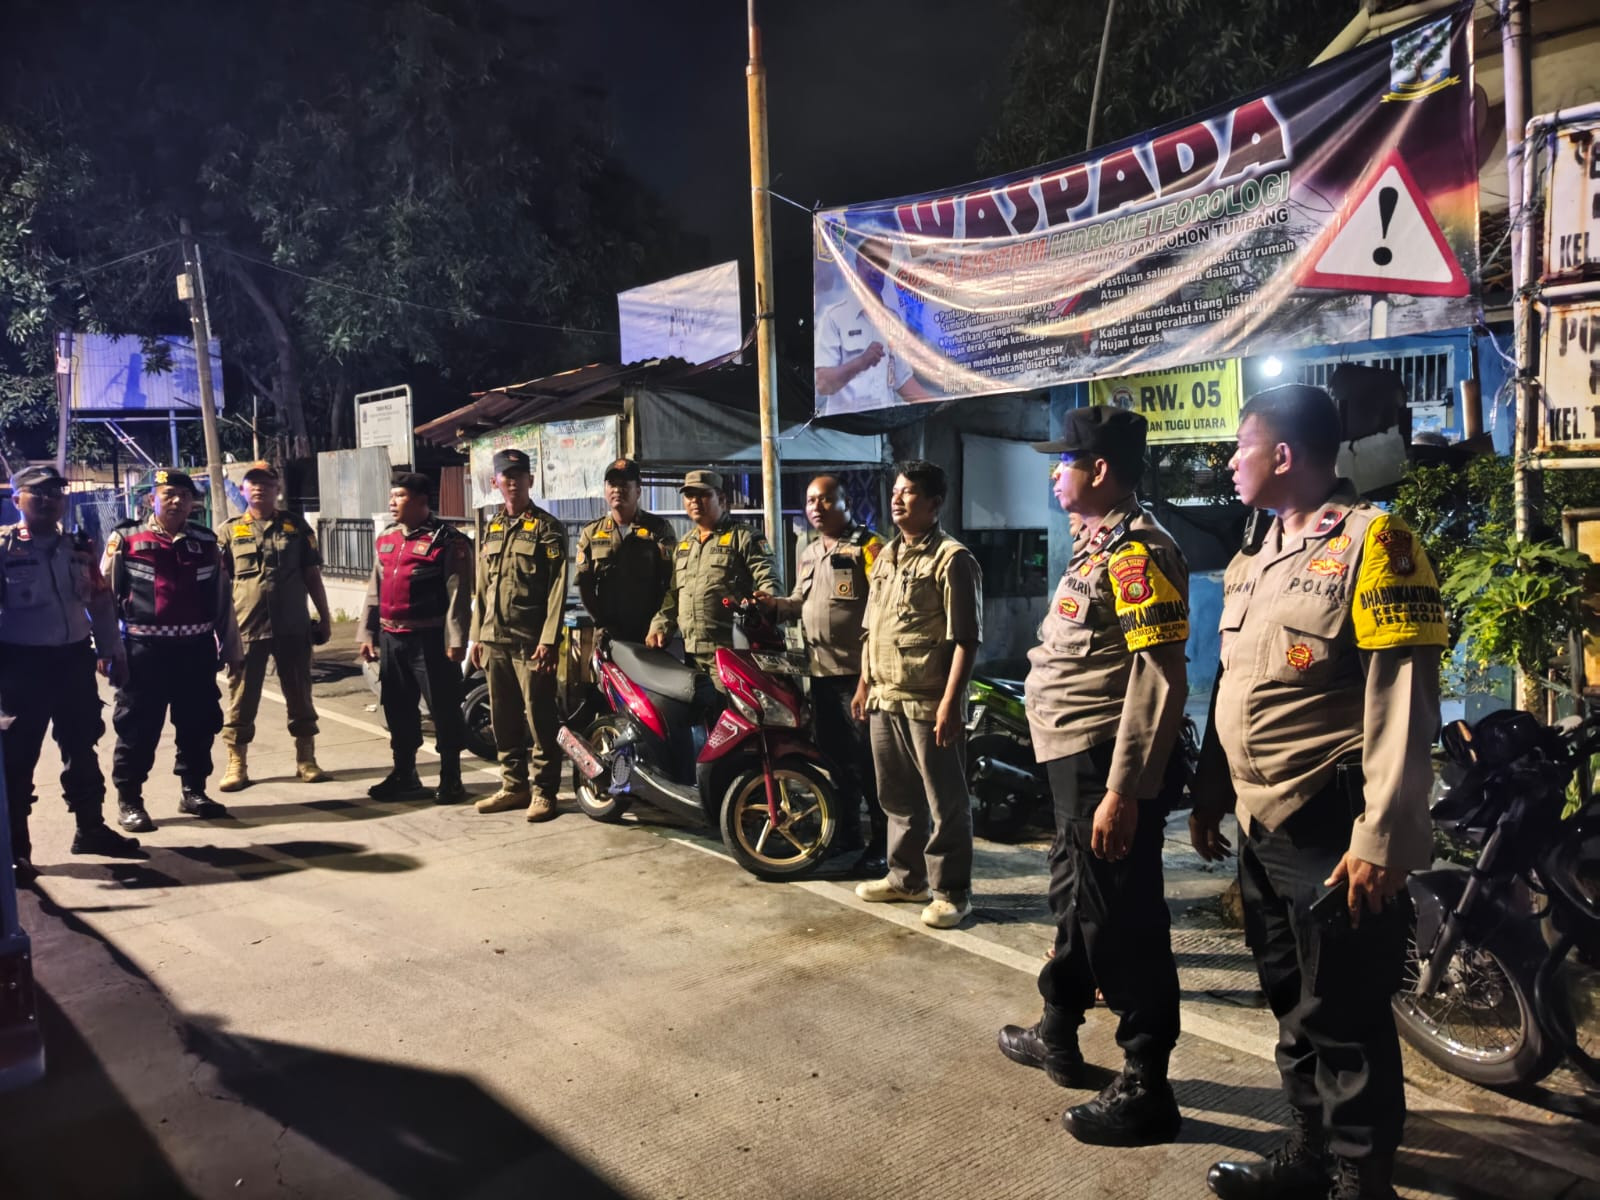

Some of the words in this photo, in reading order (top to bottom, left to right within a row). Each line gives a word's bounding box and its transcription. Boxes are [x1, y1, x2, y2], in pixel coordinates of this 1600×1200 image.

[896, 97, 1292, 258] WASPADA
[959, 238, 1048, 279] EKSTRIM
[1049, 171, 1291, 259] HIDROMETEOROLOGI
[1128, 234, 1158, 256] DAN
[1157, 226, 1210, 250] POHON
[1214, 208, 1289, 239] TUMBANG
[1100, 273, 1144, 290] Pastikan
[1146, 264, 1184, 281] saluran
[1202, 249, 1251, 268] disekitar
[1255, 240, 1295, 257] rumah
[1100, 289, 1124, 301] Atau
[1205, 264, 1241, 280] dalam
[969, 311, 1005, 327] informasi
[1136, 304, 1192, 322] mendekati
[1193, 296, 1223, 312] tiang
[1226, 291, 1258, 306] listrik
[943, 331, 981, 347] Perhatikan
[1098, 325, 1127, 340] Kabel
[1129, 321, 1153, 335] atau
[1155, 311, 1206, 332] peralatan
[966, 341, 986, 353] deras
[987, 336, 1009, 351] angin
[1099, 337, 1130, 351] Hujan
[1132, 332, 1164, 347] deras.
[973, 355, 1012, 369] mendekati
[1012, 349, 1039, 364] pohon
[1040, 345, 1064, 357] besar
[992, 364, 1024, 378] kencang
[1026, 358, 1058, 371] disertai
[1140, 383, 1185, 413] RW.
[1191, 380, 1222, 409] 05
[1165, 419, 1191, 432] TUGU
[1193, 417, 1226, 430] UTARA
